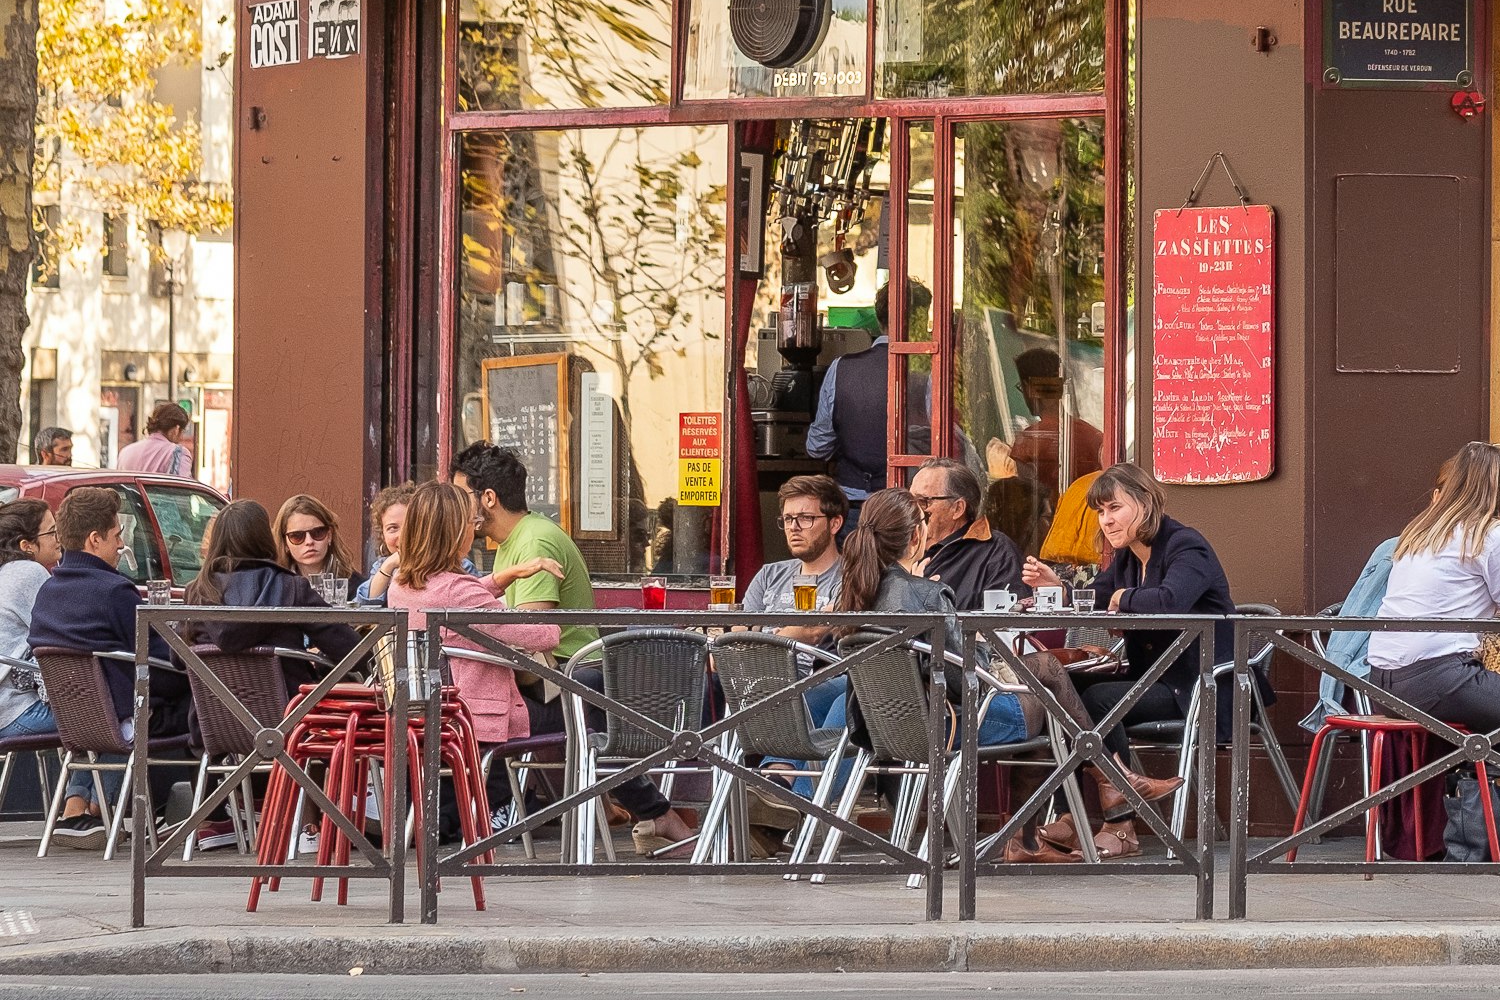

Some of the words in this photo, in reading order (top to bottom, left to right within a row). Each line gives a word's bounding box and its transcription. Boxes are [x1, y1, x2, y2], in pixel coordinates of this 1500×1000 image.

[253, 0, 295, 23] ADAM
[1339, 21, 1461, 42] BEAUREPAIRE
[250, 20, 299, 68] COST
[1197, 215, 1231, 234] LES
[1157, 238, 1264, 256] ZASSIETTES
[683, 416, 717, 425] TOILETTES
[692, 438, 707, 446] AUX
[680, 448, 719, 457] CLIENT(E)S
[687, 463, 701, 472] PAS
[703, 463, 711, 472] DE
[685, 477, 707, 486] VENTE
[680, 491, 718, 501] EMPORTER
